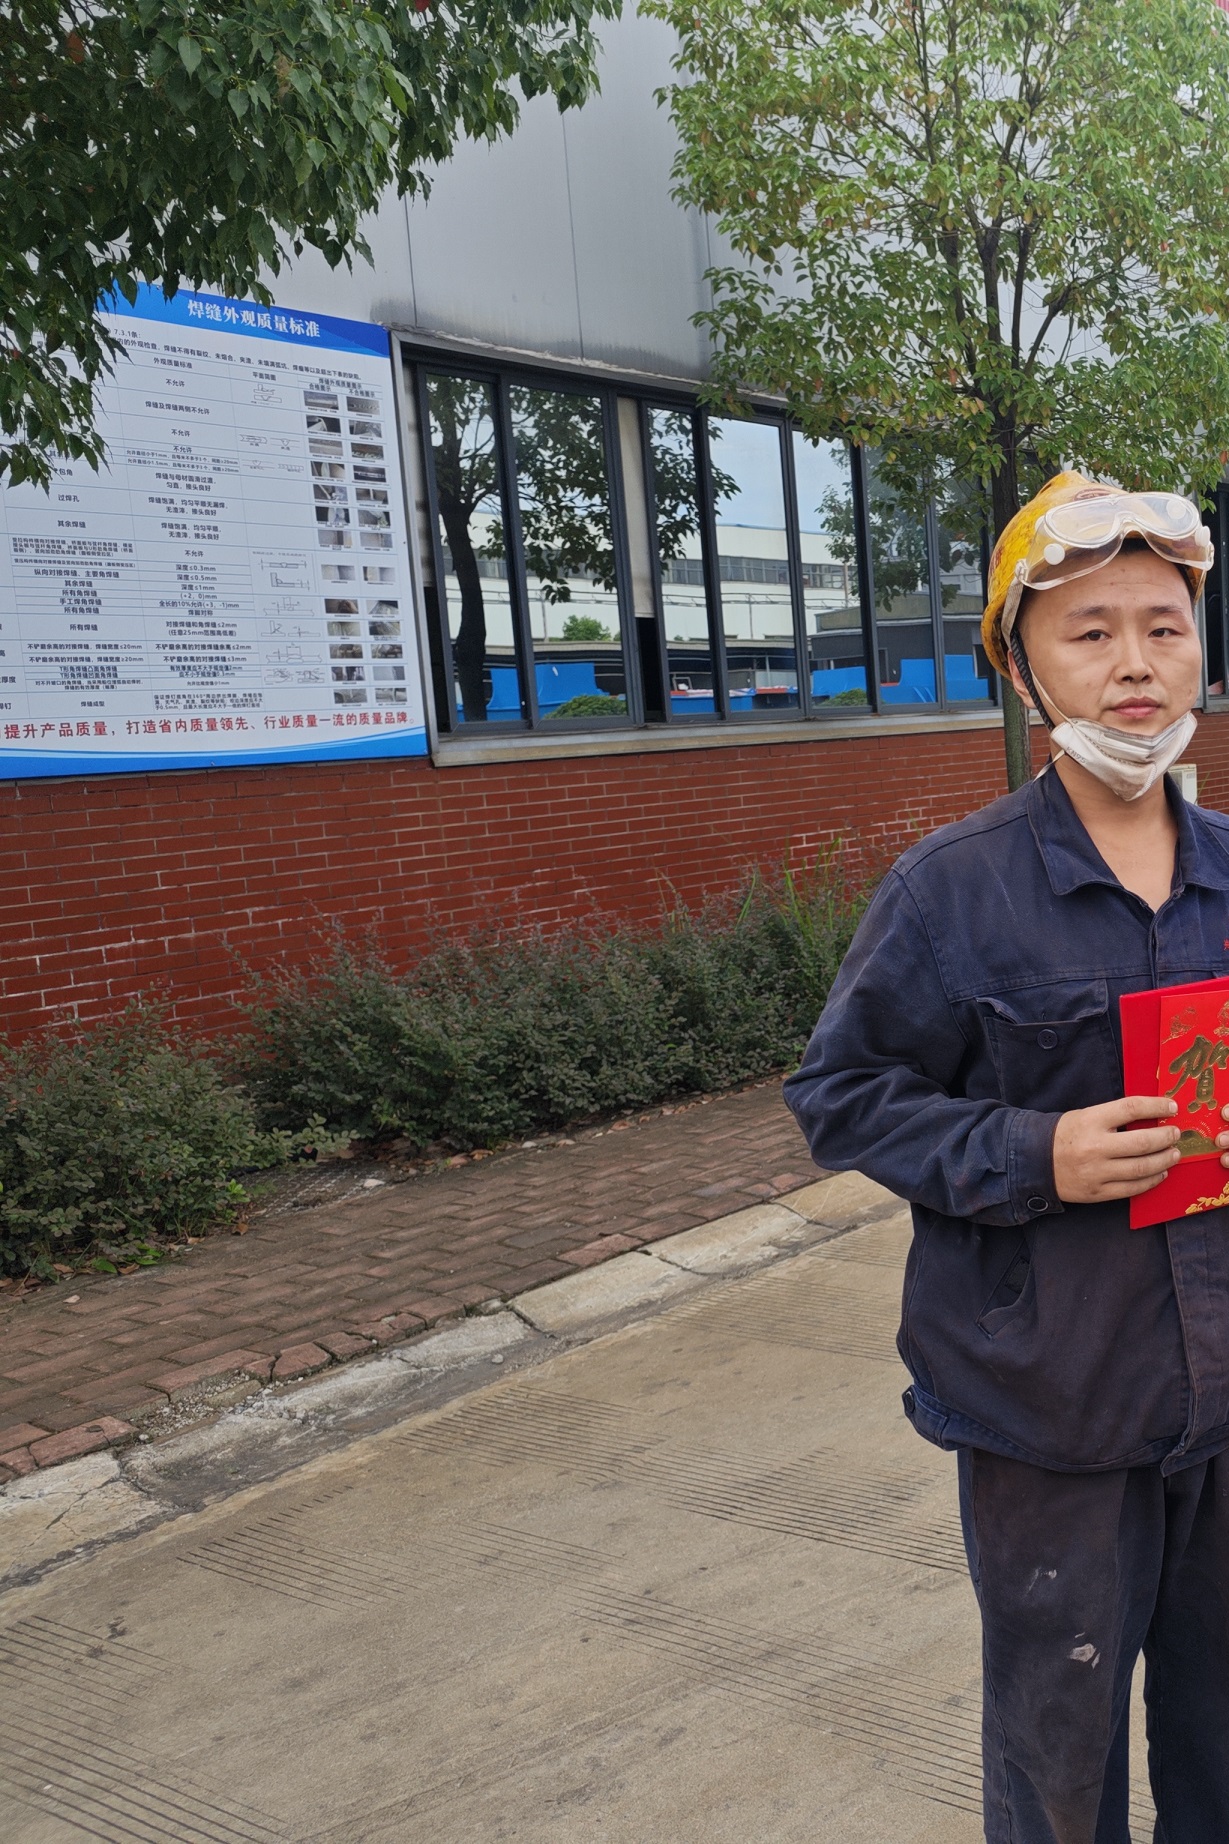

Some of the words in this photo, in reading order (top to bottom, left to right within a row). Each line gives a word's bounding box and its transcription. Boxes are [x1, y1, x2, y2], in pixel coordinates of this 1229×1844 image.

[187, 299, 321, 338] 焊缝外观质量标准
[153, 357, 193, 370] 外观质量标准
[165, 378, 186, 388] 不允许
[145, 400, 211, 416] 焊缝及焊缝两侧不允许
[171, 428, 191, 438] 不允许
[173, 445, 193, 454] 不允许
[58, 494, 80, 503] 过焊孔
[57, 520, 87, 529] 其余焊缝
[184, 549, 205, 558] 不允许
[175, 563, 217, 572] 深度≤0.3mm
[34, 568, 120, 578] 纵向对接焊缝、主要角焊缝
[177, 573, 218, 582] 深度≤0.5mm
[64, 580, 93, 588] 其余焊缝
[181, 583, 216, 592] 深度≤1mm
[62, 589, 98, 598] 所有角焊缝
[59, 597, 102, 606] 手工焊角焊缝
[64, 606, 100, 615] 所有角焊缝
[69, 623, 99, 632] 所有焊缝
[0, 676, 16, 684] 厚度
[4, 711, 415, 740] 提升产品质量，打造省内质量领先、行业质量一流的质量品牌。
